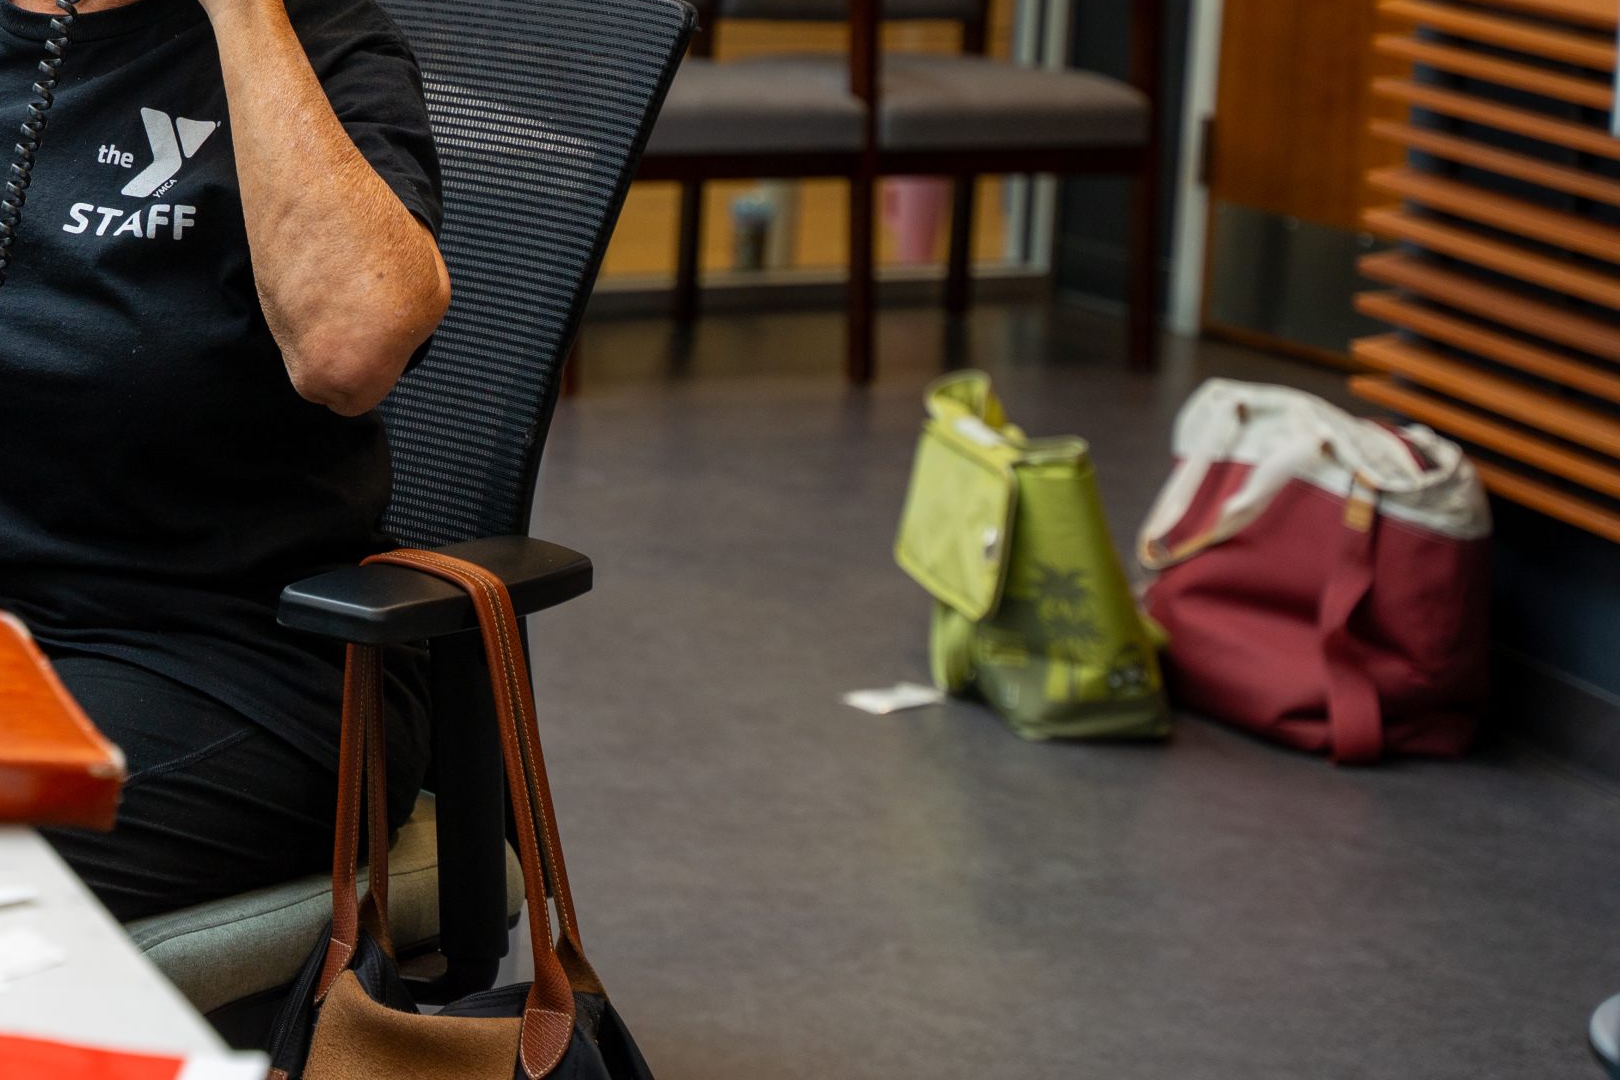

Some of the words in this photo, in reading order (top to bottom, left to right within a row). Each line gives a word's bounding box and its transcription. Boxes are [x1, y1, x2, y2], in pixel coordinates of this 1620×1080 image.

[97, 144, 134, 169] the
[152, 178, 178, 199] YMCA
[62, 202, 197, 240] STAFF
